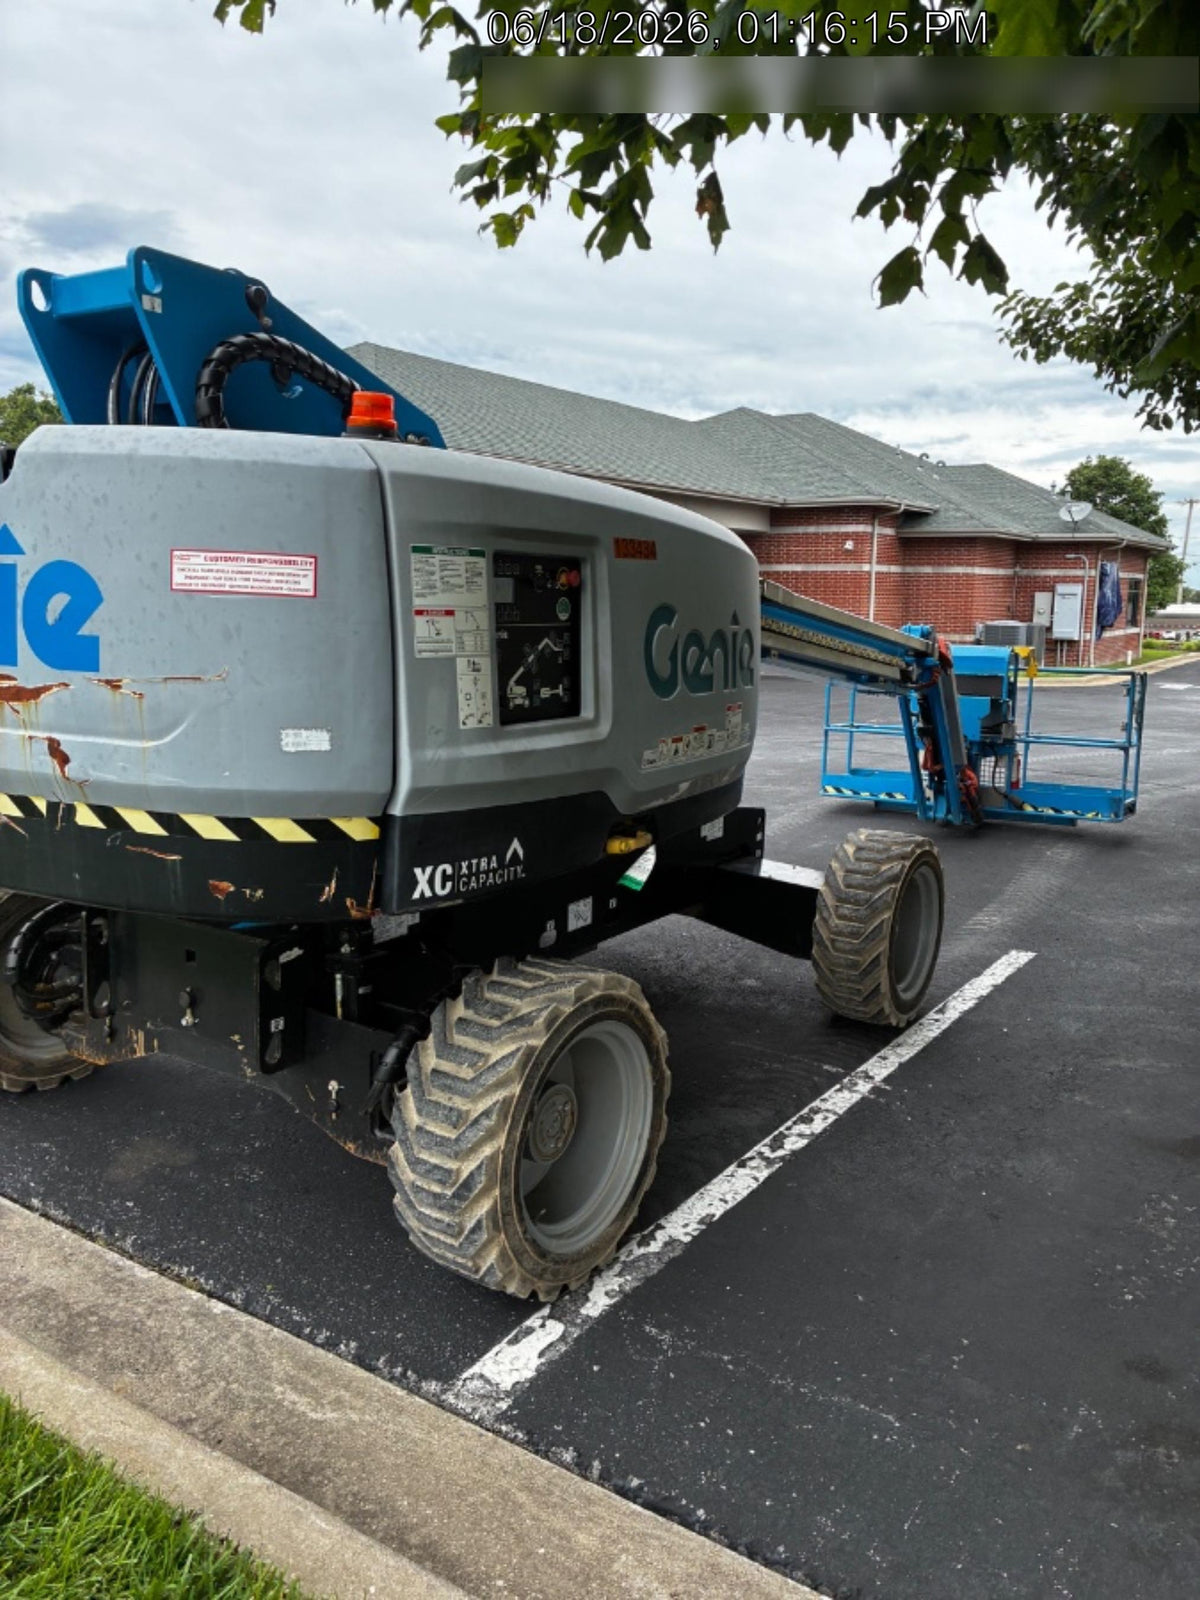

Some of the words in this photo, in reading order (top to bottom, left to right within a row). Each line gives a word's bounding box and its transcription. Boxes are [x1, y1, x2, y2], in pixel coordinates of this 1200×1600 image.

[204, 555, 246, 564] CUSTOMER
[247, 557, 314, 568] RESPONSIBILITY
[644, 603, 755, 700] Genie
[460, 855, 498, 875] XTRA
[460, 865, 524, 892] CAPACITY
[411, 863, 454, 900] XC
